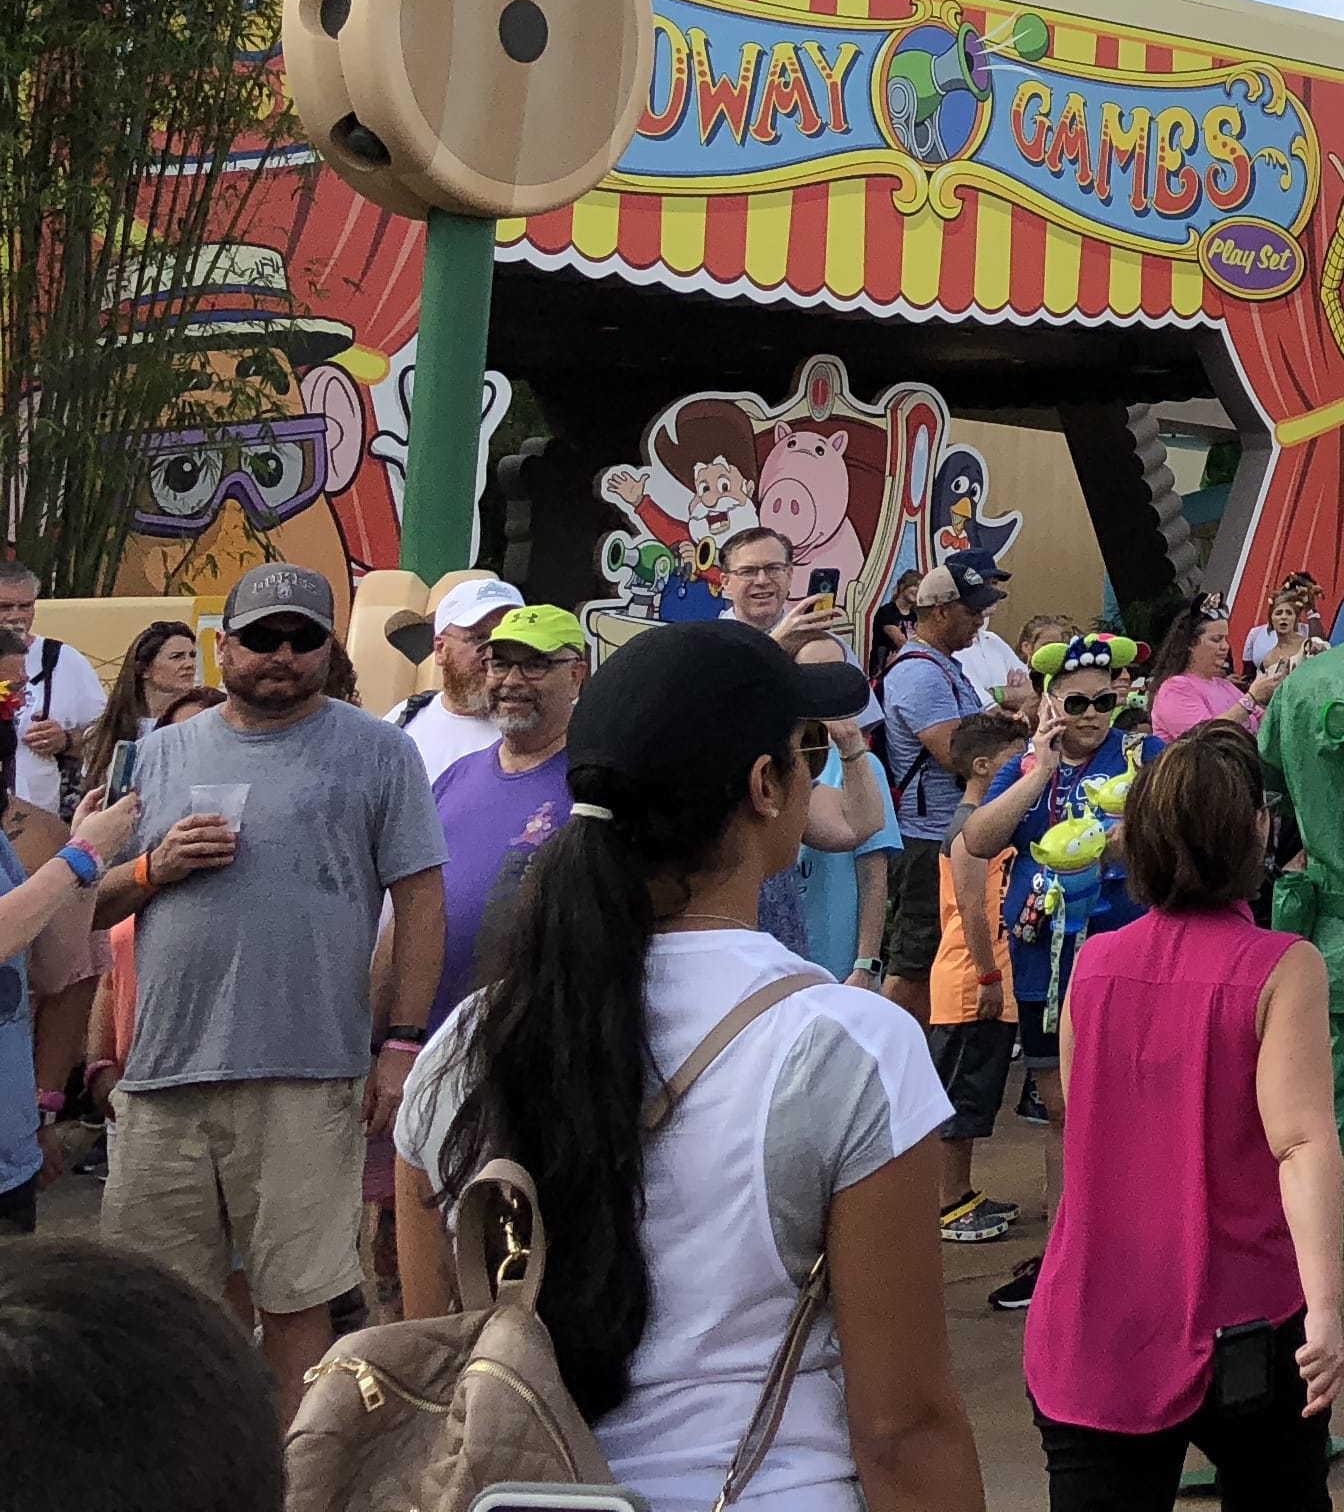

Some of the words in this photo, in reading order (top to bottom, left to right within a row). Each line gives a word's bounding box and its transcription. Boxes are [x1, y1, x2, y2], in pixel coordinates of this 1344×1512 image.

[1010, 80, 1254, 219] GAMES
[1208, 238, 1256, 274] Play
[1257, 244, 1292, 271] Set
